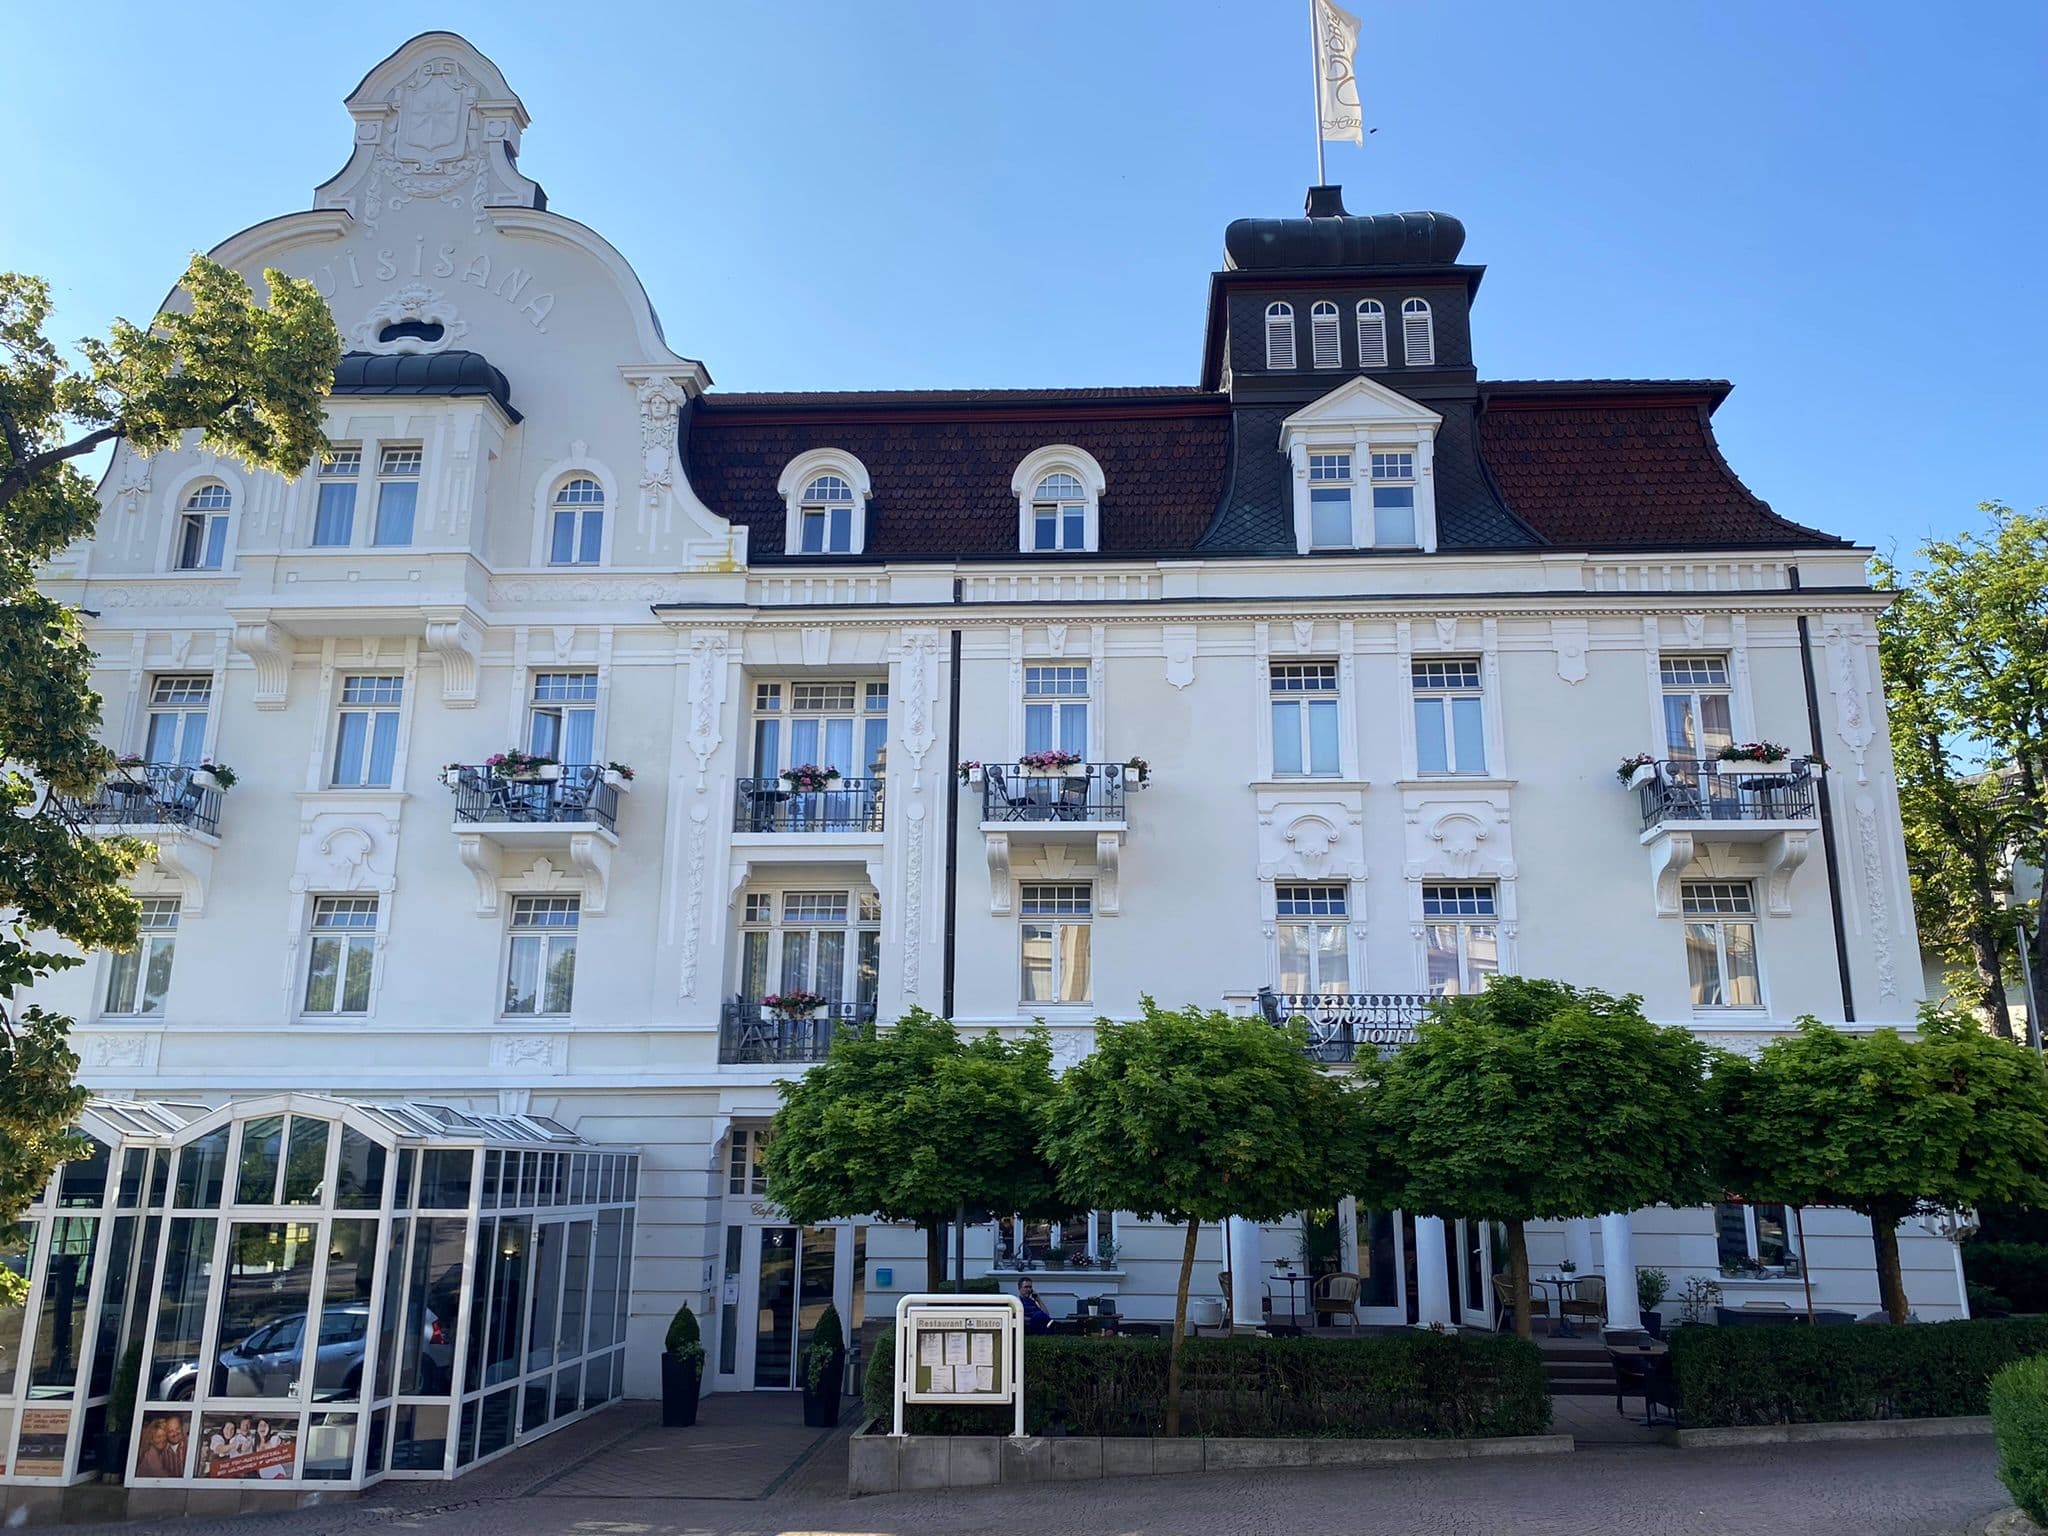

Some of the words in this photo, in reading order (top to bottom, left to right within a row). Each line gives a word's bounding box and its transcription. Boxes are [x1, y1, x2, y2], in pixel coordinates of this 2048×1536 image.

[1354, 1029, 1418, 1044] HOTEL
[918, 1319, 963, 1328] Restaurant
[976, 1319, 1001, 1328] Bistro
